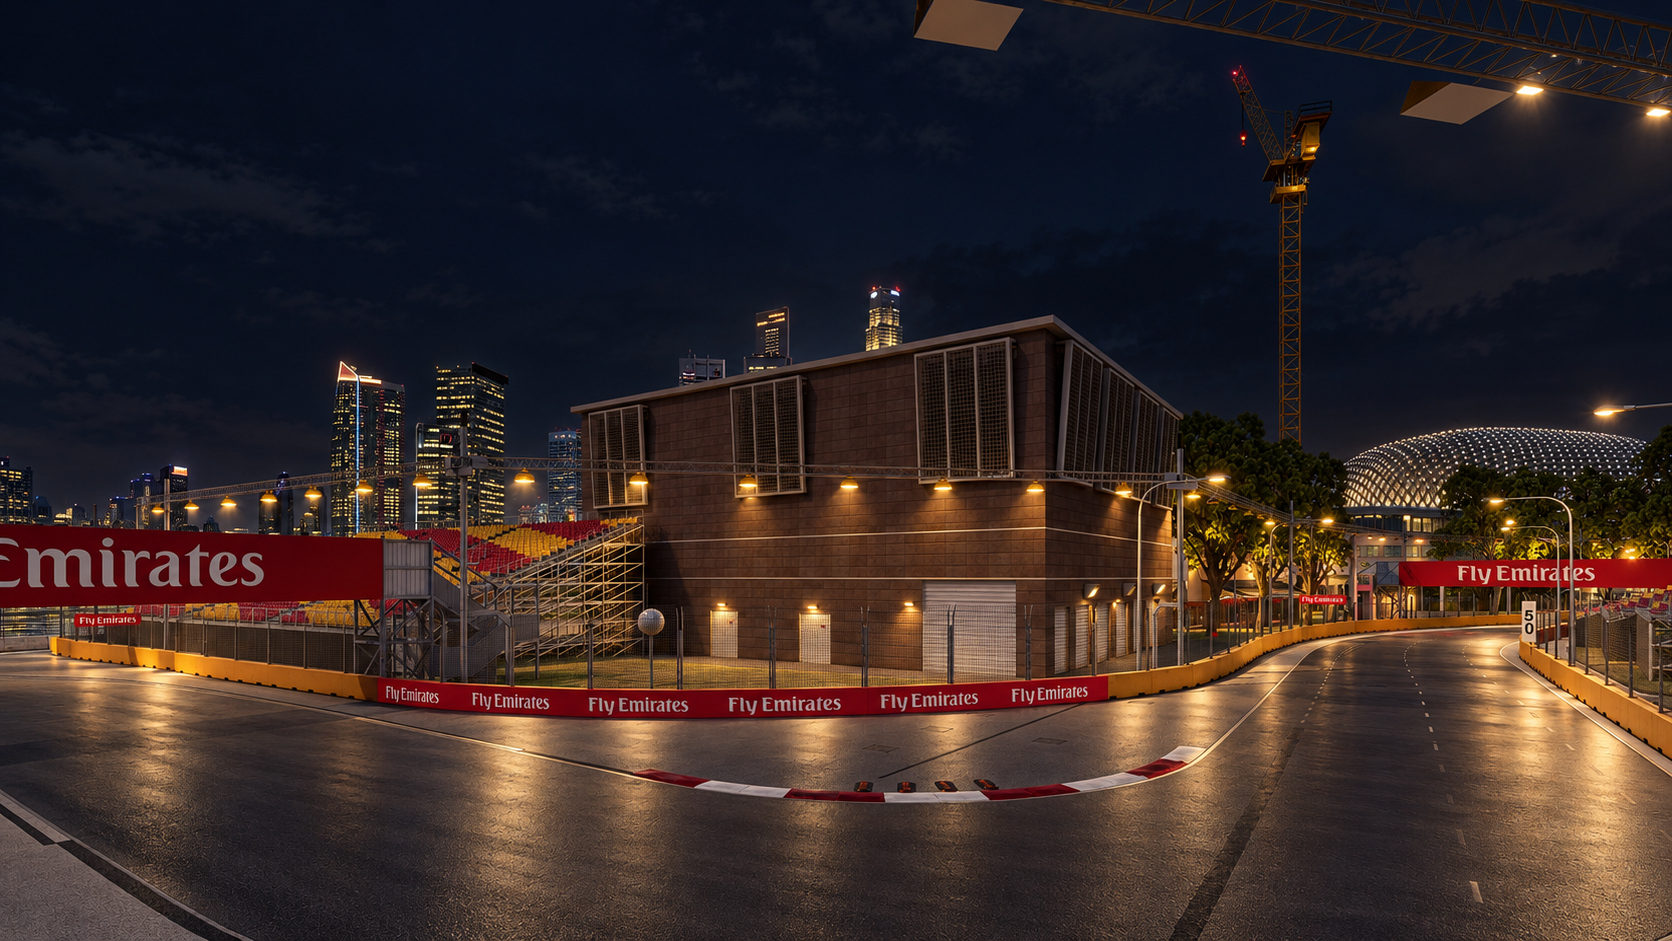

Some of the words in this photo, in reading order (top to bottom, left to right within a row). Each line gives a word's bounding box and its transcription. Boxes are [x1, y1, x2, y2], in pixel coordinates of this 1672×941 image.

[1457, 565, 1492, 585] Fly
[1496, 564, 1596, 582] Emirates
[79, 616, 95, 626] Fly
[97, 615, 137, 625] Emirates
[385, 685, 400, 703] Fly
[401, 687, 440, 704] Emirates
[472, 692, 492, 711] Fly
[494, 693, 550, 710] Emirates
[880, 694, 909, 712] Fly
[911, 691, 979, 708] Emirates
[1011, 688, 1035, 705] Fly
[1037, 686, 1089, 701] Emirates
[588, 697, 615, 716] Fly
[618, 696, 689, 713] Emirates
[728, 697, 758, 716] Fly
[762, 695, 842, 712] Emirates
